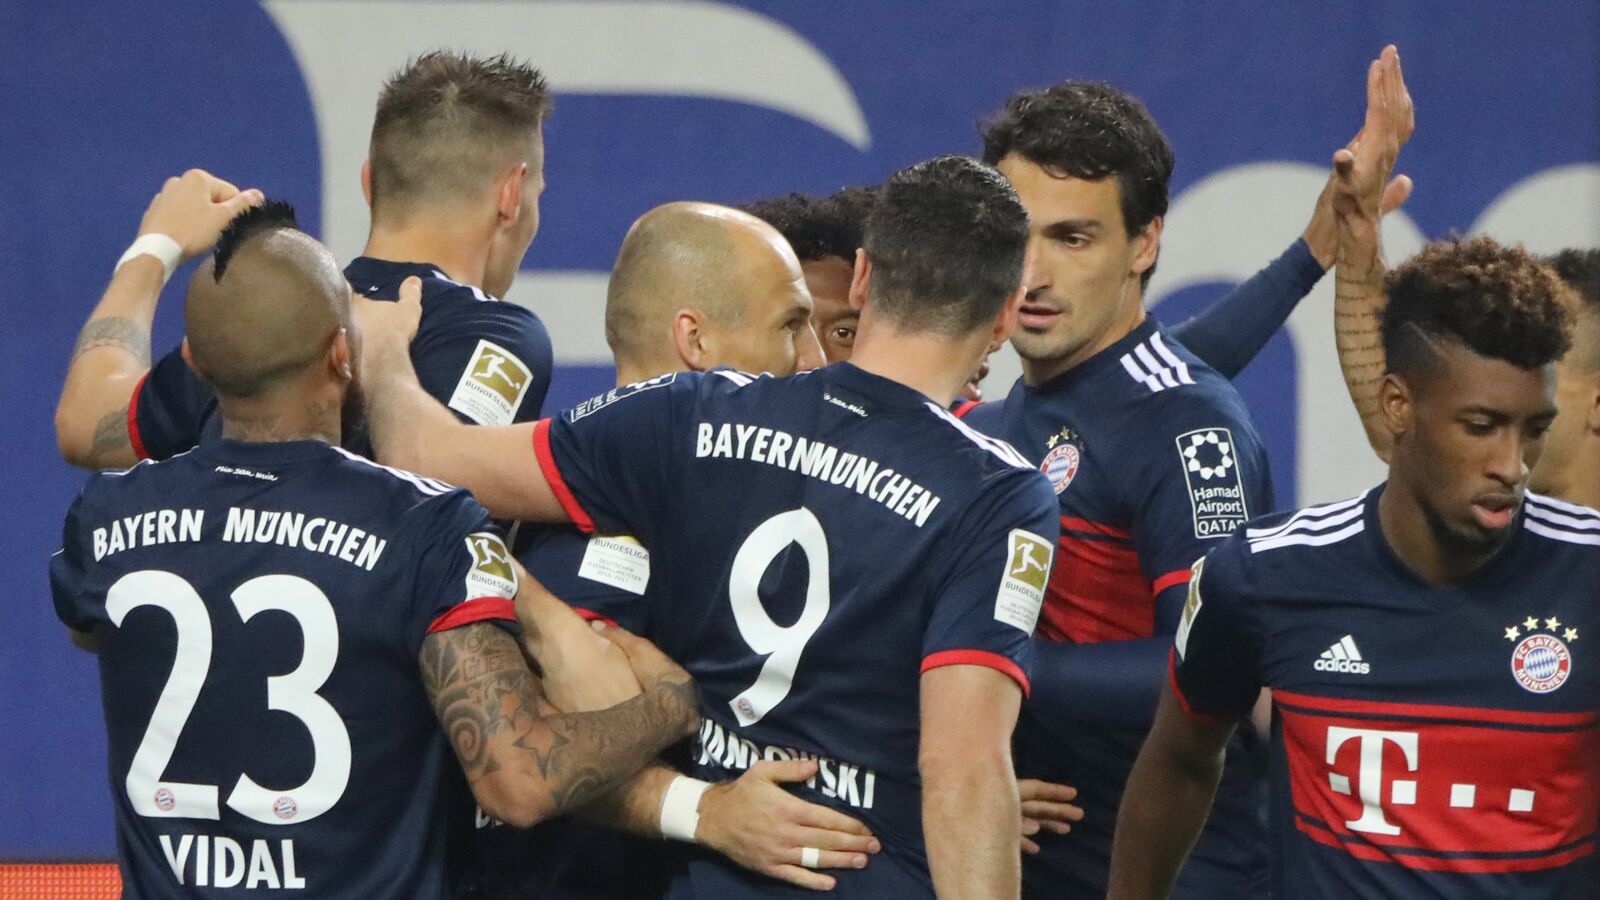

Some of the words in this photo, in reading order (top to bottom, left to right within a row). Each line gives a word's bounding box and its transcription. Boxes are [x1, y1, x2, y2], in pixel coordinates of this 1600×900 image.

[1193, 485, 1240, 502] Hamad
[1197, 500, 1243, 515] Airport
[93, 508, 205, 563] BAYERN
[222, 507, 387, 572] MÜNCHEN
[594, 538, 649, 561] BUNDESLIGA
[729, 506, 830, 727] 9
[1516, 645, 1528, 660] FC
[1527, 638, 1567, 661] BAYERN
[1313, 658, 1371, 675] adidas
[105, 569, 352, 825] 23
[158, 834, 306, 889] VIDAL
